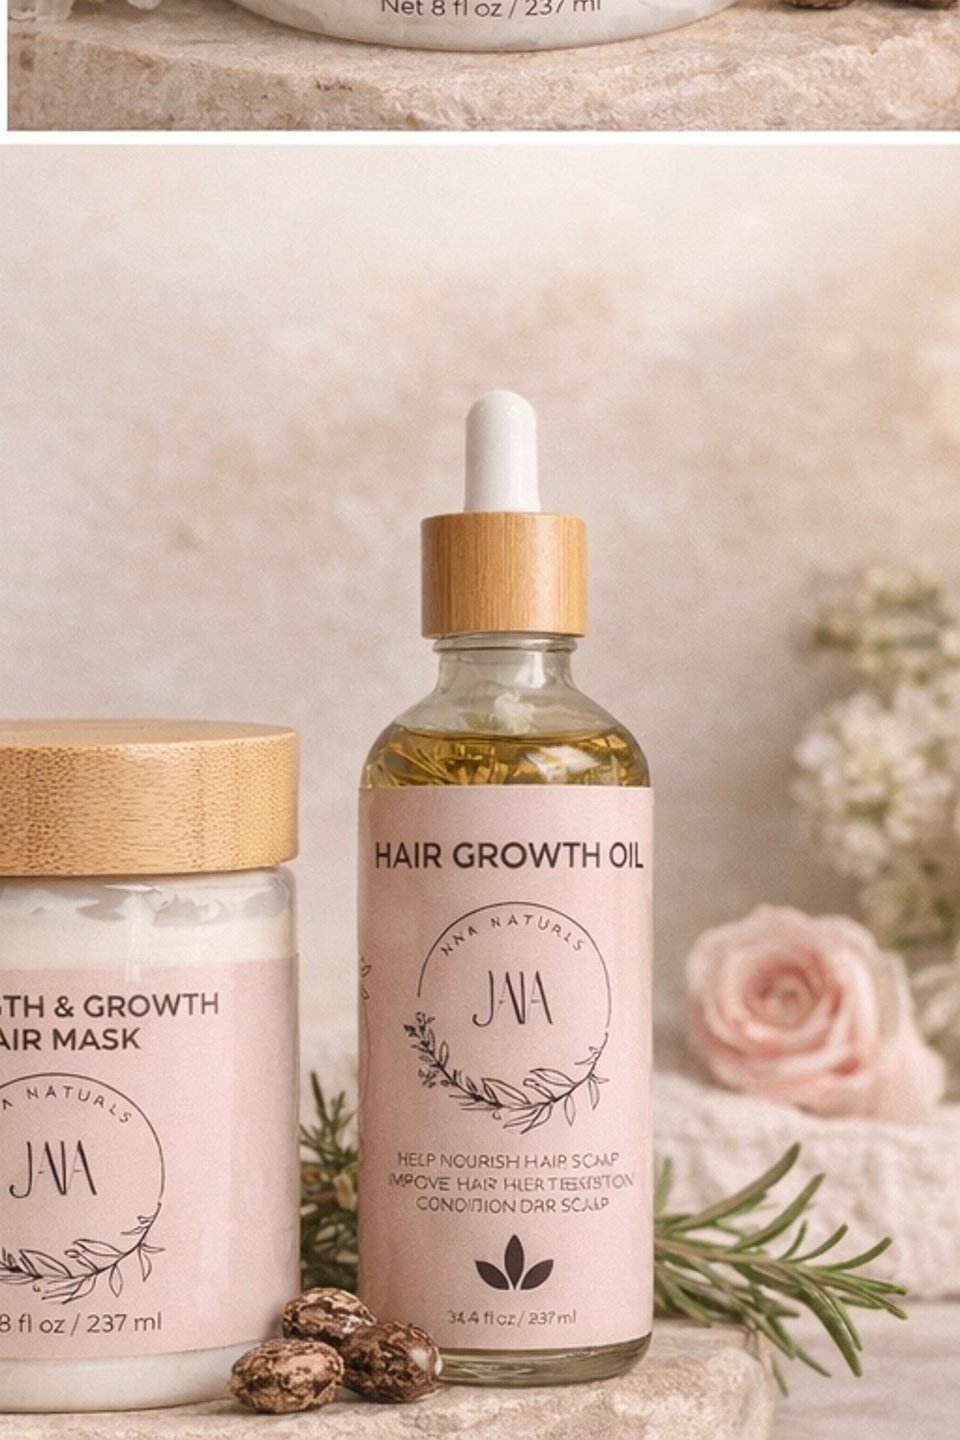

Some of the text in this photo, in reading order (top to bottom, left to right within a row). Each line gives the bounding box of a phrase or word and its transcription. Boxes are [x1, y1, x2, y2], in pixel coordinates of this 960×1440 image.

[474, 3, 502, 17] oz
[376, 842, 644, 869] HAIR GROWTH OIL
[54, 996, 74, 1018] &
[83, 993, 218, 1018] GROWTH
[53, 1028, 140, 1051] MASK
[440, 1154, 520, 1169] NOURISH
[18, 1313, 32, 1333] fl
[39, 1319, 65, 1334] oz
[70, 1313, 81, 1337] /
[87, 1314, 127, 1333] 237
[134, 1312, 161, 1331] ml
[557, 1309, 576, 1324] ml
